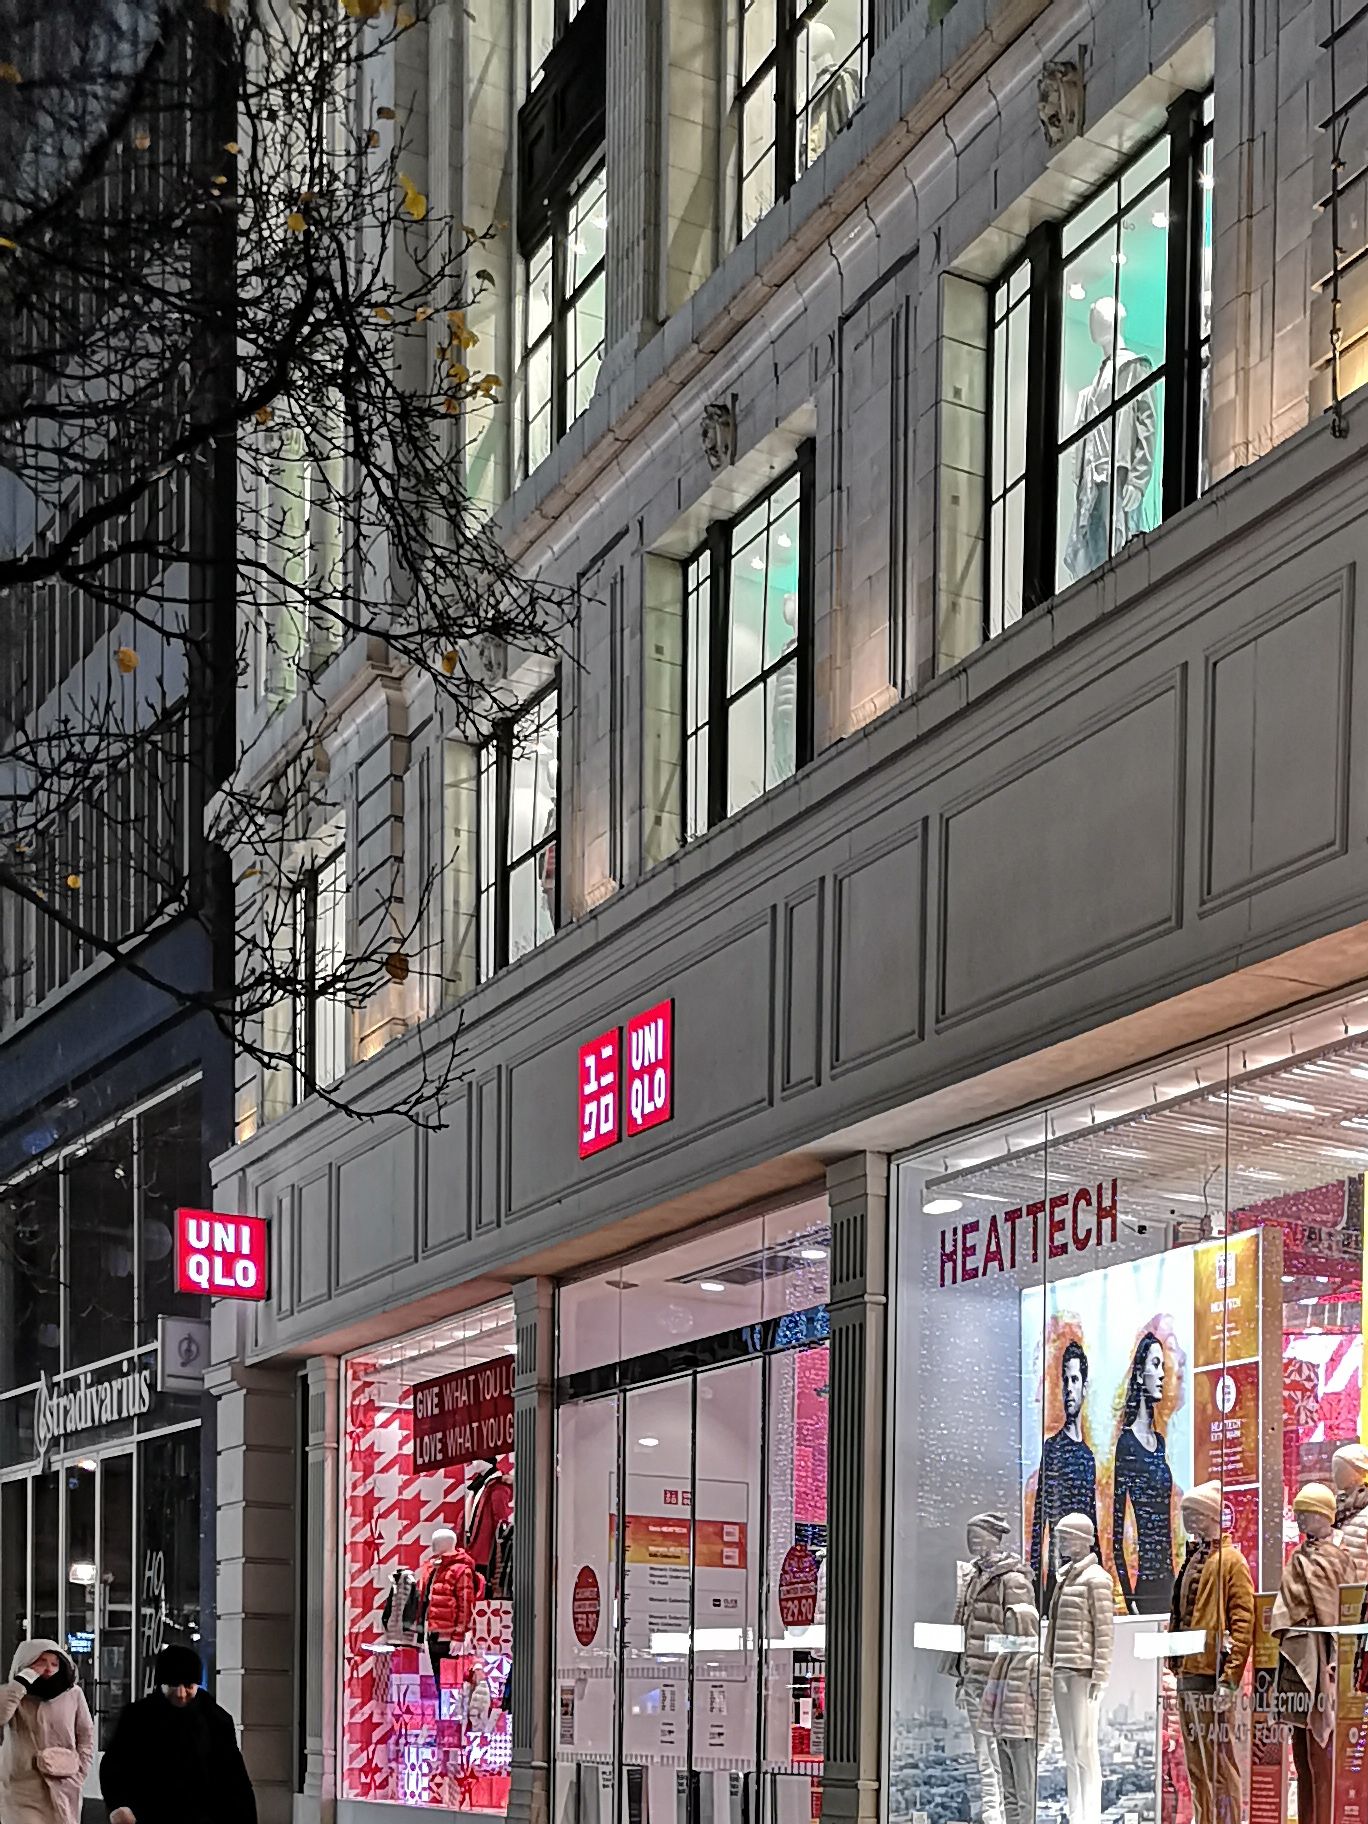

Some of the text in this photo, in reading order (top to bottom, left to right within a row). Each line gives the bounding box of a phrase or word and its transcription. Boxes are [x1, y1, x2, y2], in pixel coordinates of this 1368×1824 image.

[630, 1017, 664, 1071] UNI
[583, 1044, 614, 1096] ユニ
[582, 1091, 614, 1143] クロ
[630, 1066, 666, 1125] QLO
[187, 1218, 251, 1255] UNI
[939, 1177, 1118, 1288] HEATTECH
[187, 1253, 257, 1289] QLO
[416, 1362, 516, 1419] GIVE WHAT YOU LO
[416, 1431, 443, 1465] LOVE
[446, 1421, 479, 1458] WHAT
[481, 1415, 504, 1450] YOU
[143, 1550, 164, 1599] HO
[142, 1607, 164, 1658] HO
[143, 1665, 156, 1698] H
[1242, 1691, 1313, 1713] COLLECTION
[1207, 1722, 1229, 1743] AND
